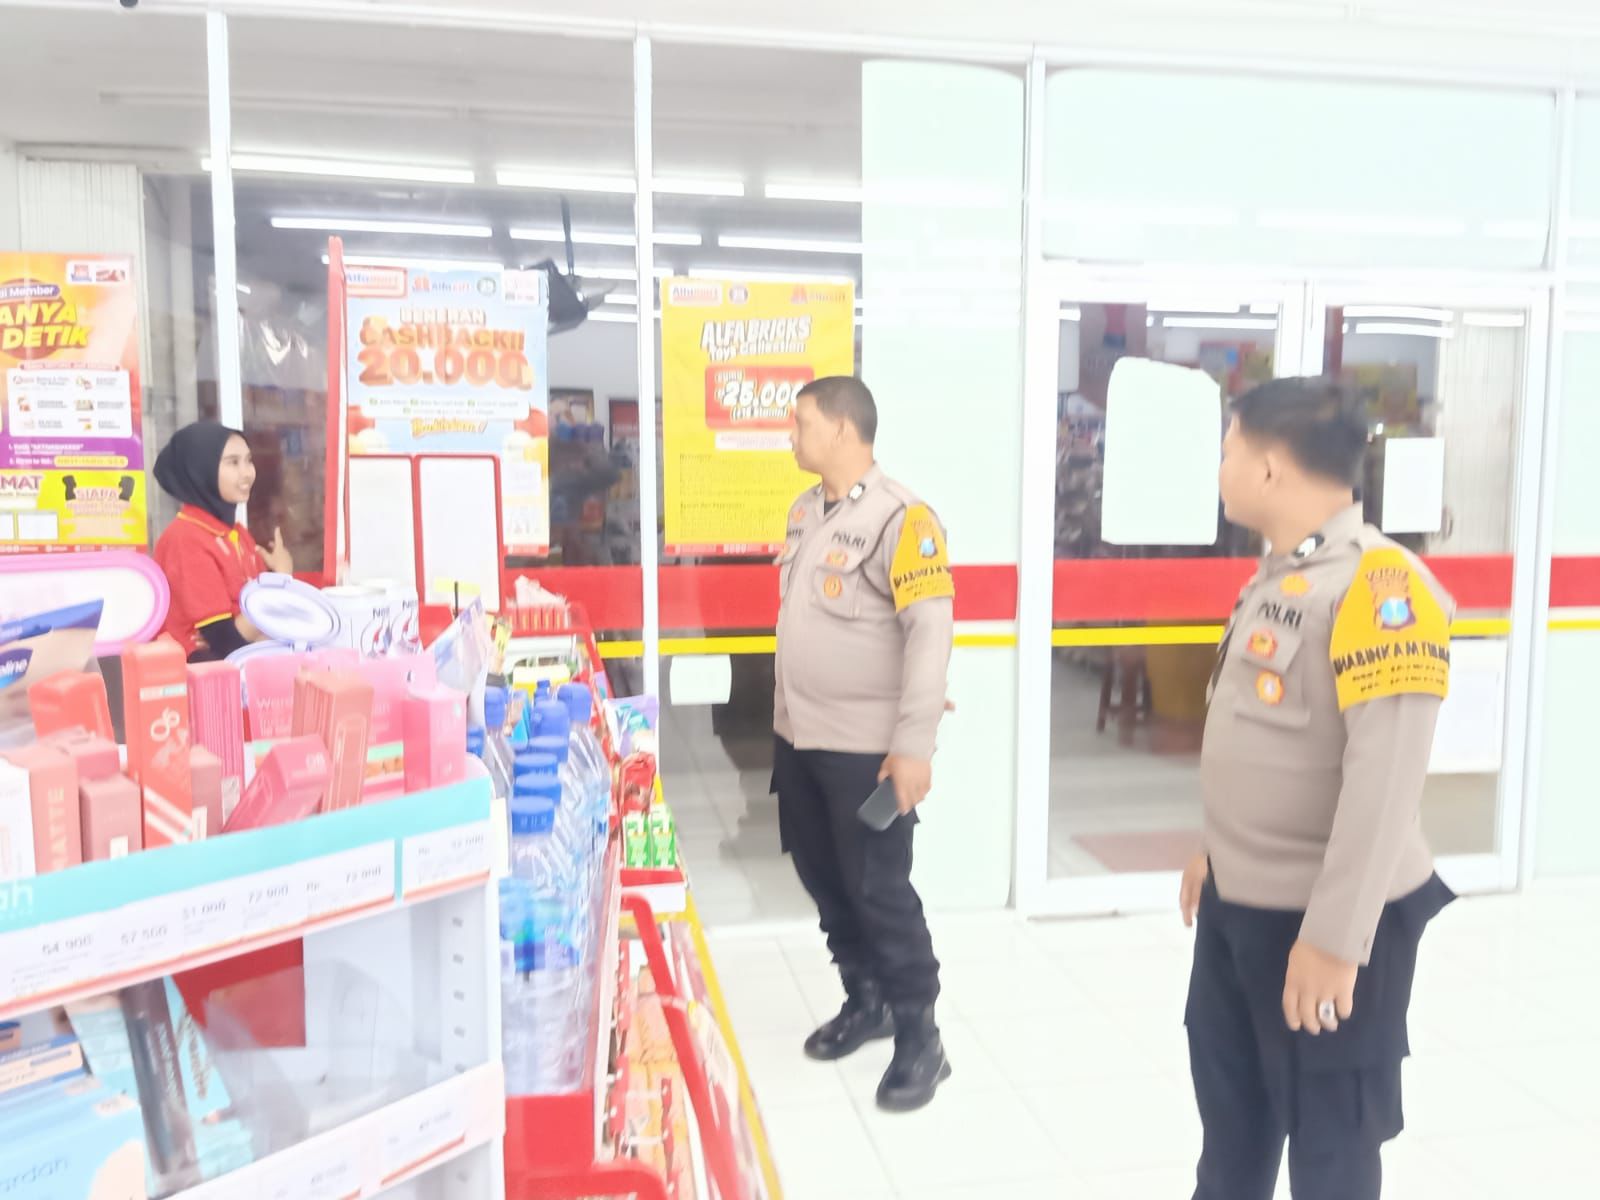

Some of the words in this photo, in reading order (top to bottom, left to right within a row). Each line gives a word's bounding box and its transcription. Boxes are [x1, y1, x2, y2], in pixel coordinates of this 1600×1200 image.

[9, 286, 54, 297] Member
[2, 325, 91, 351] DETIK
[831, 531, 867, 549] POLRI
[1257, 601, 1303, 630] POLRI
